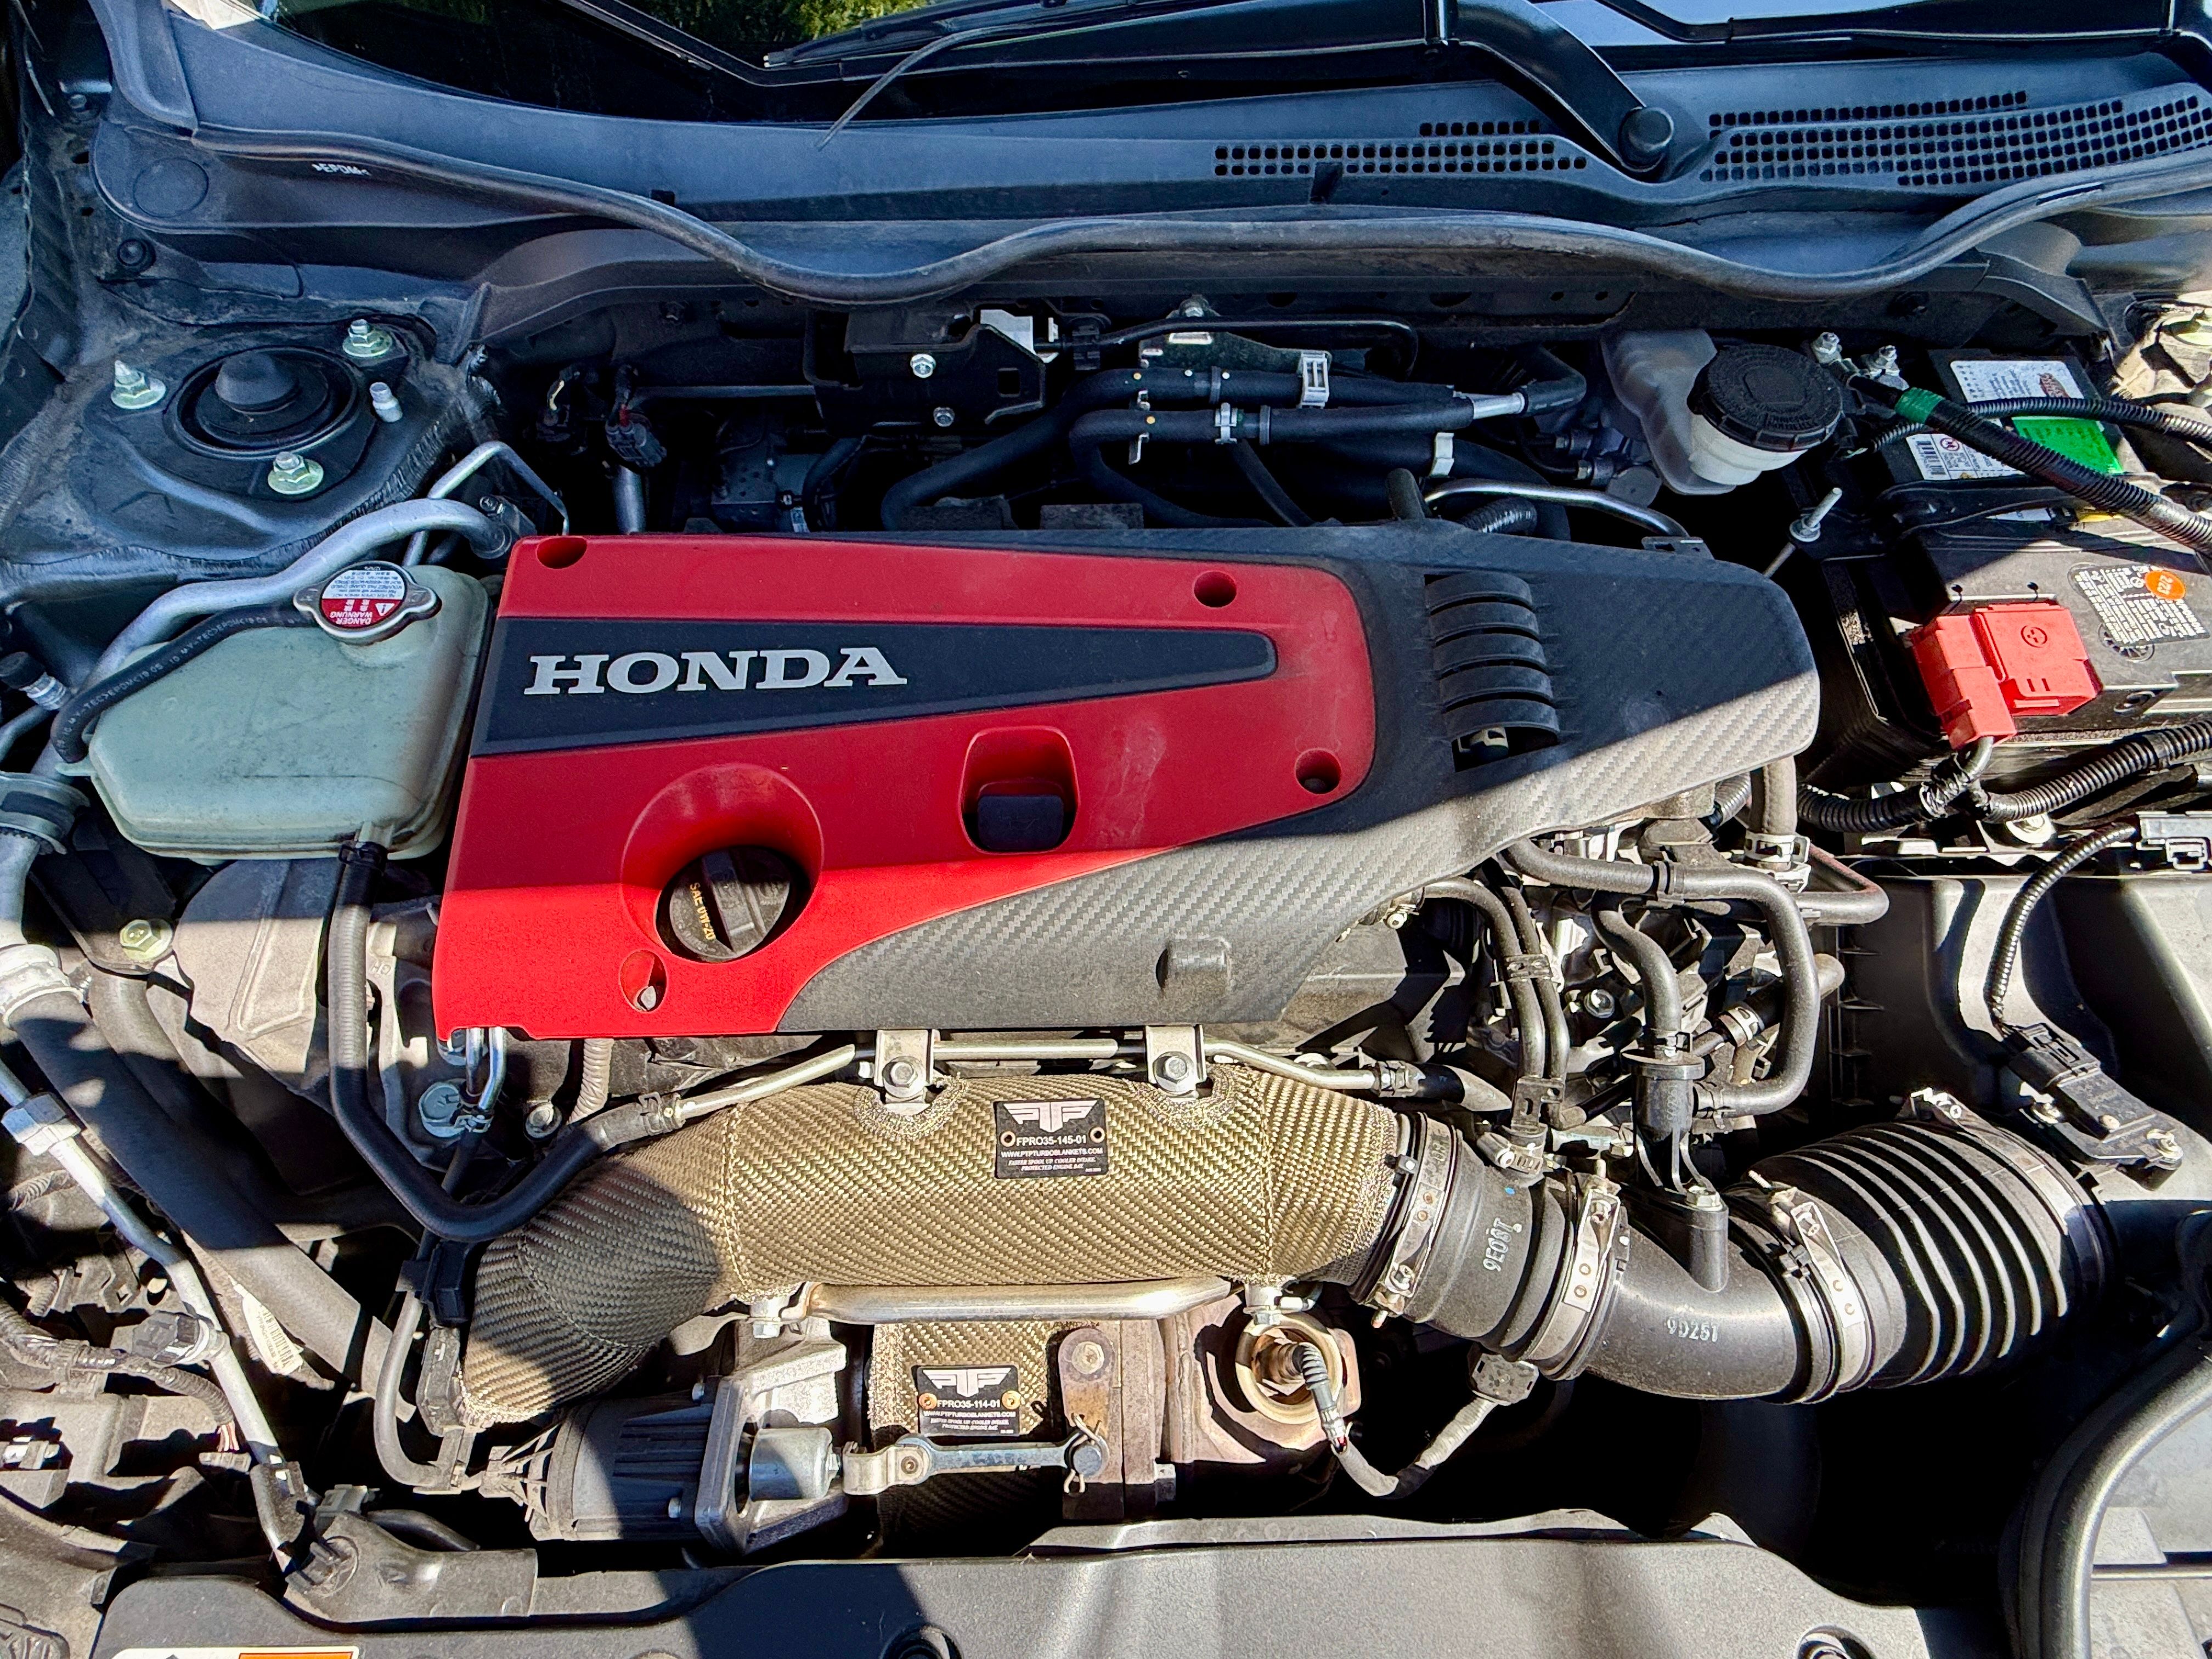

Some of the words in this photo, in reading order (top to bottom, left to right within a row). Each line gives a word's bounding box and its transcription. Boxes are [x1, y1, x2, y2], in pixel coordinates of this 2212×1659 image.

[524, 647, 907, 695] HONDA
[690, 882, 703, 906] SAE
[1016, 1135, 1086, 1147] FPRO35-145-01
[937, 1400, 1001, 1408] FPRO35-114-01
